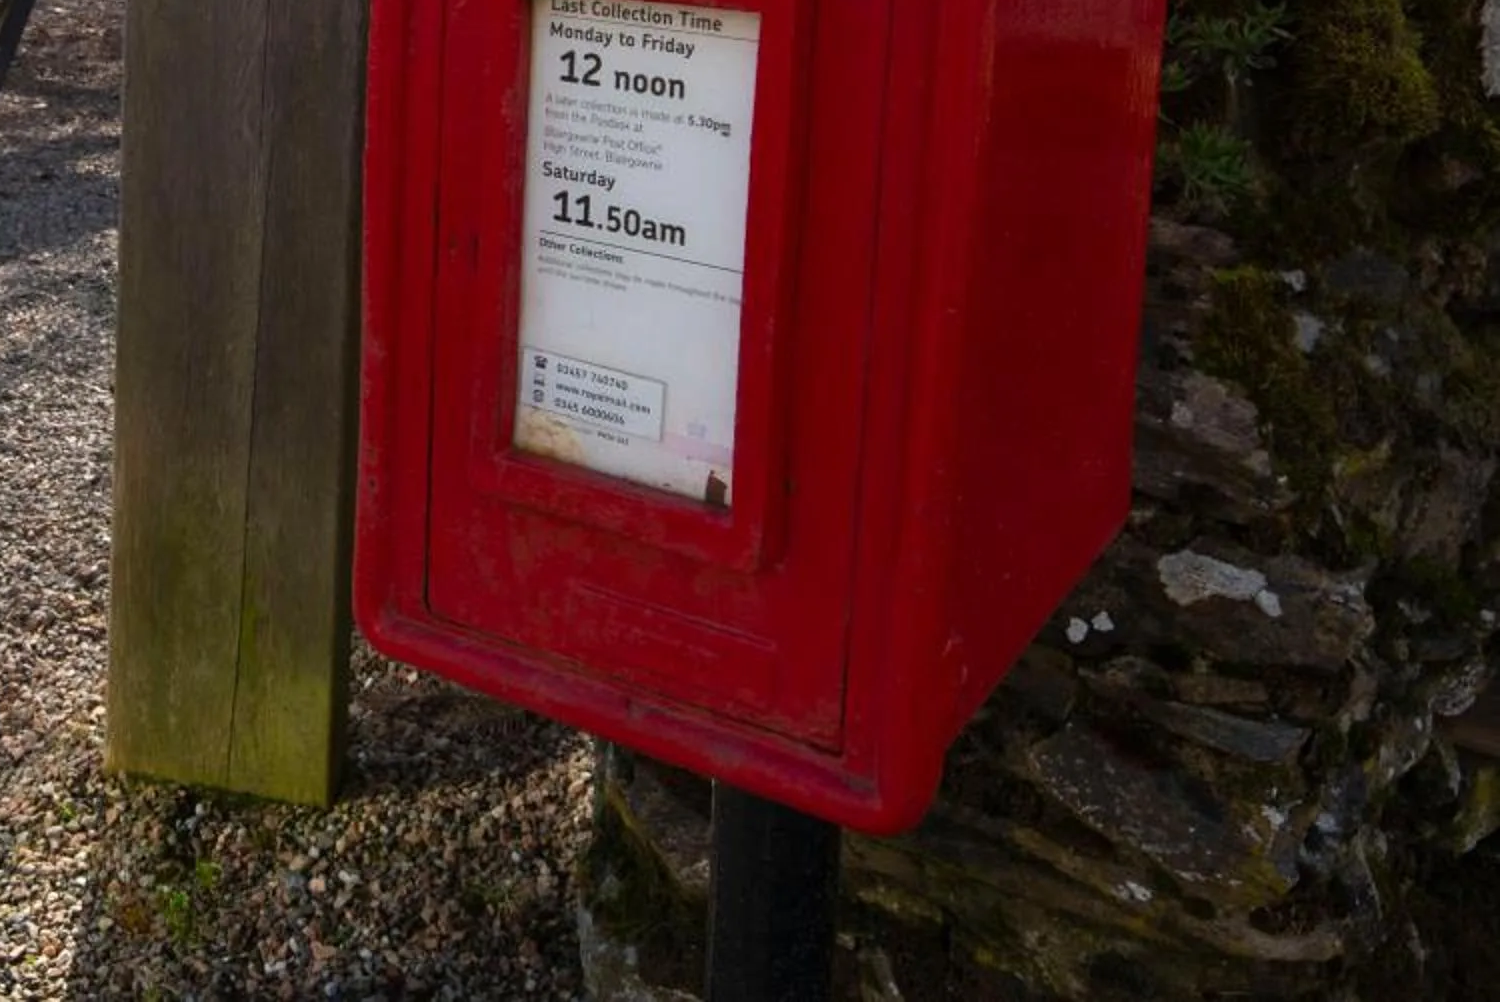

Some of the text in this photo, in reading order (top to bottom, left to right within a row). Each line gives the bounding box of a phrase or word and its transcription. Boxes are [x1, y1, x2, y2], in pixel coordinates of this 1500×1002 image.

[591, 1, 673, 26] Collection
[678, 10, 723, 32] Time
[550, 21, 695, 59] Monday to Friday
[559, 49, 685, 99] 12 noon
[542, 160, 616, 191] Saturday
[553, 189, 686, 246] 11.50am
